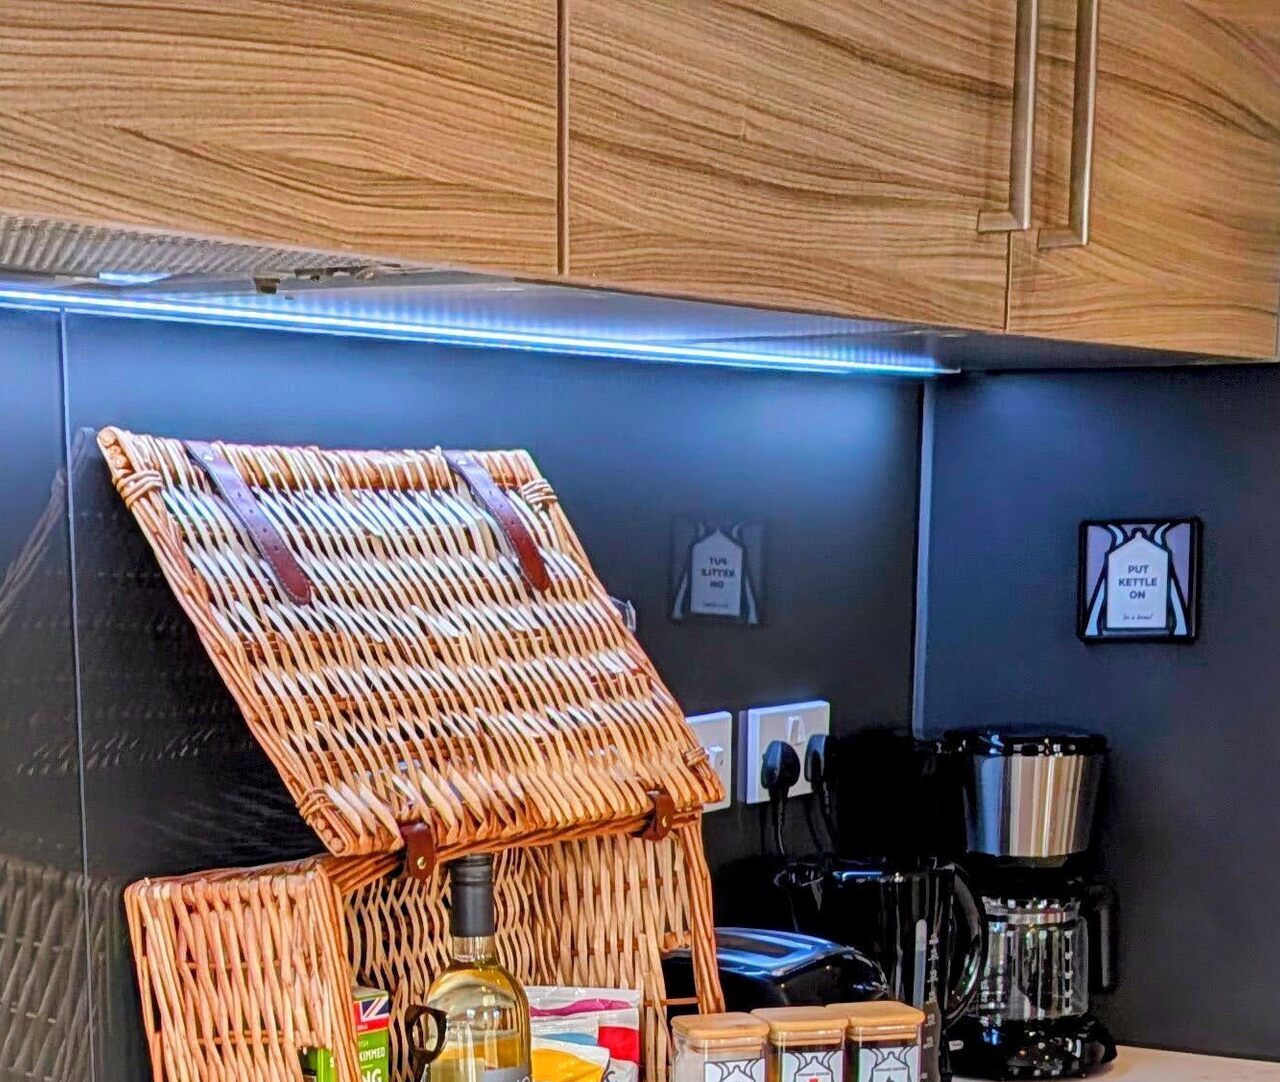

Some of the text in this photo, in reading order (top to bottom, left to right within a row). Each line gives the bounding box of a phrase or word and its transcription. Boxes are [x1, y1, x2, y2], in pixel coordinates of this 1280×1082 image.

[1127, 564, 1150, 574] PUT
[1118, 577, 1158, 587] KETTLE
[1128, 590, 1146, 600] ON
